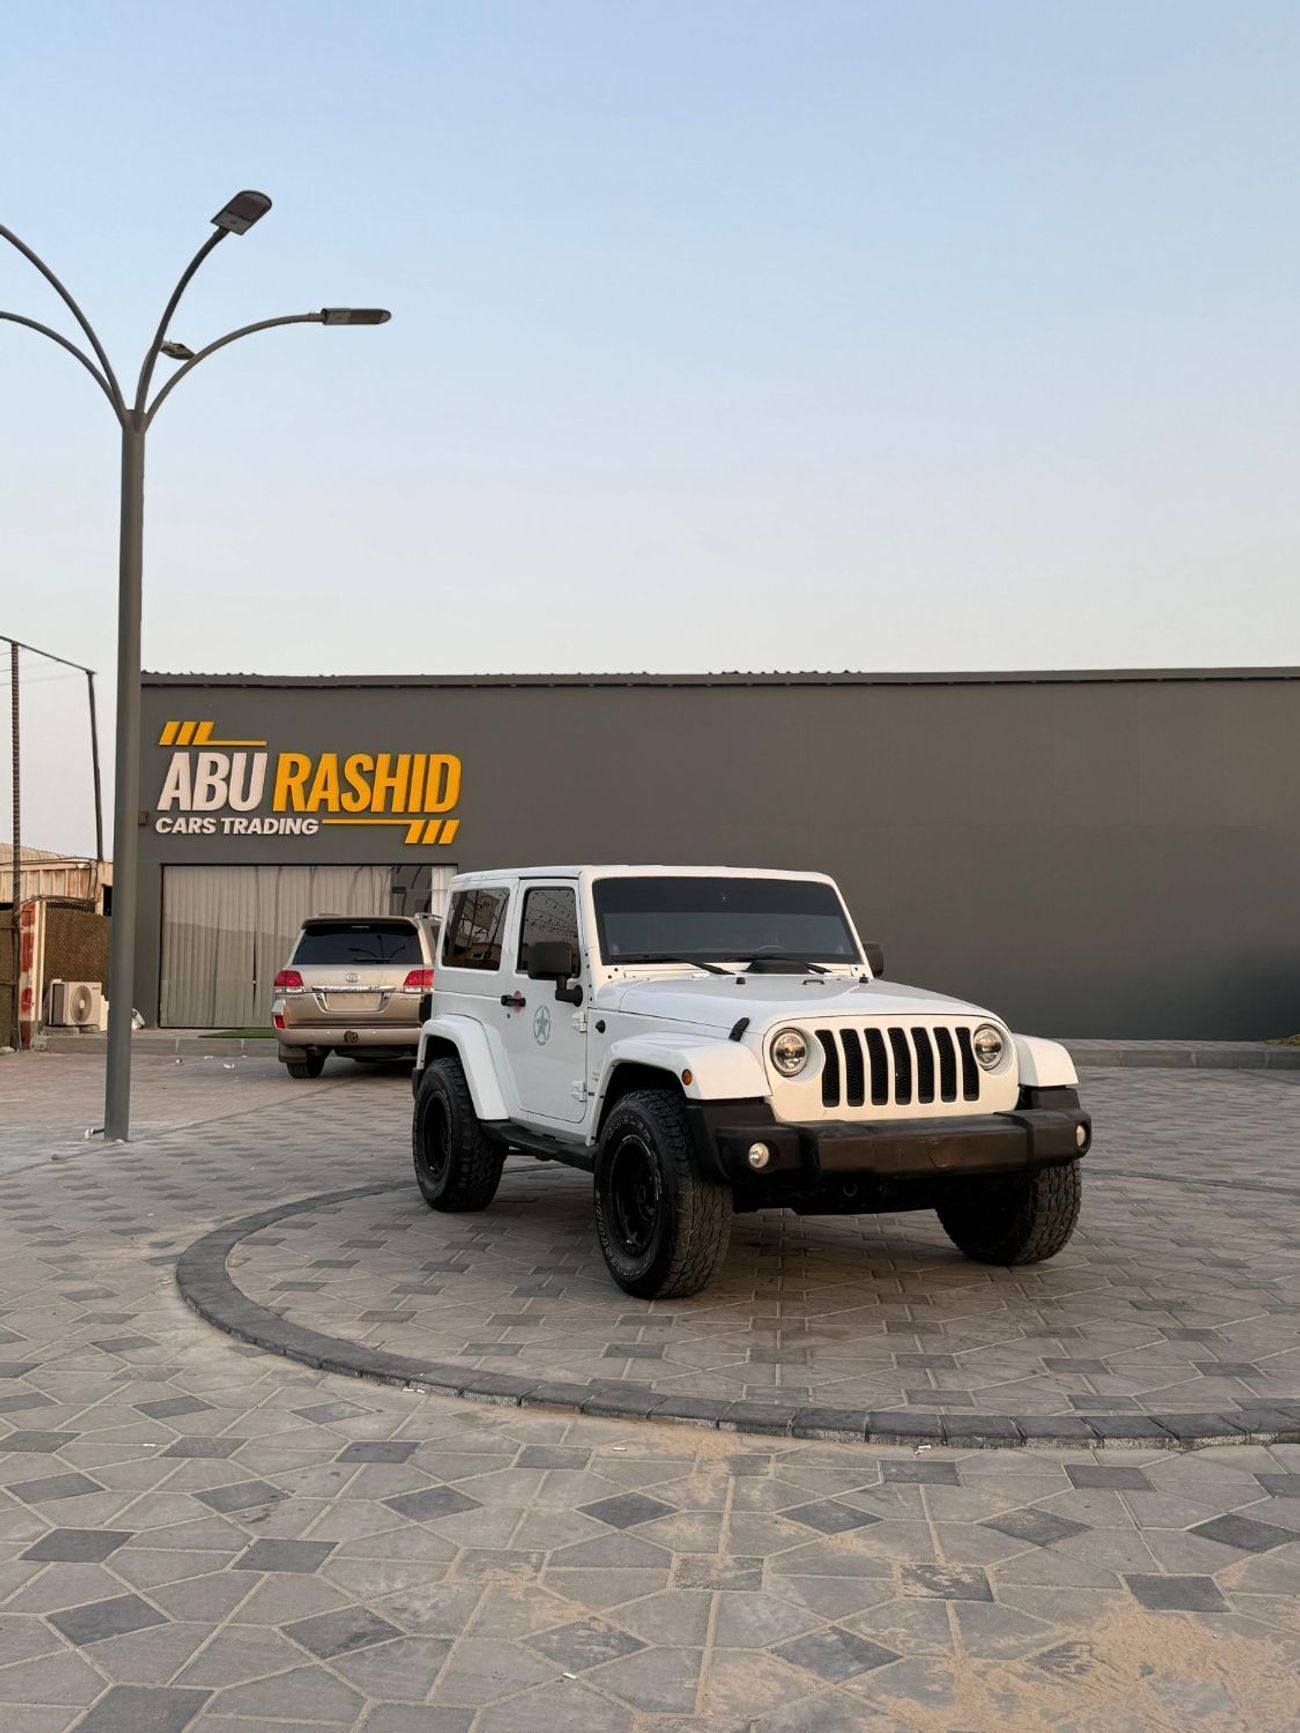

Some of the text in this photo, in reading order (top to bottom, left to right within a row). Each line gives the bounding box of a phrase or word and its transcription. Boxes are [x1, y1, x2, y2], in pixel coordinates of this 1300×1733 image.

[157, 752, 461, 813] ABU RASHID
[155, 817, 319, 835] CARS TRADING
